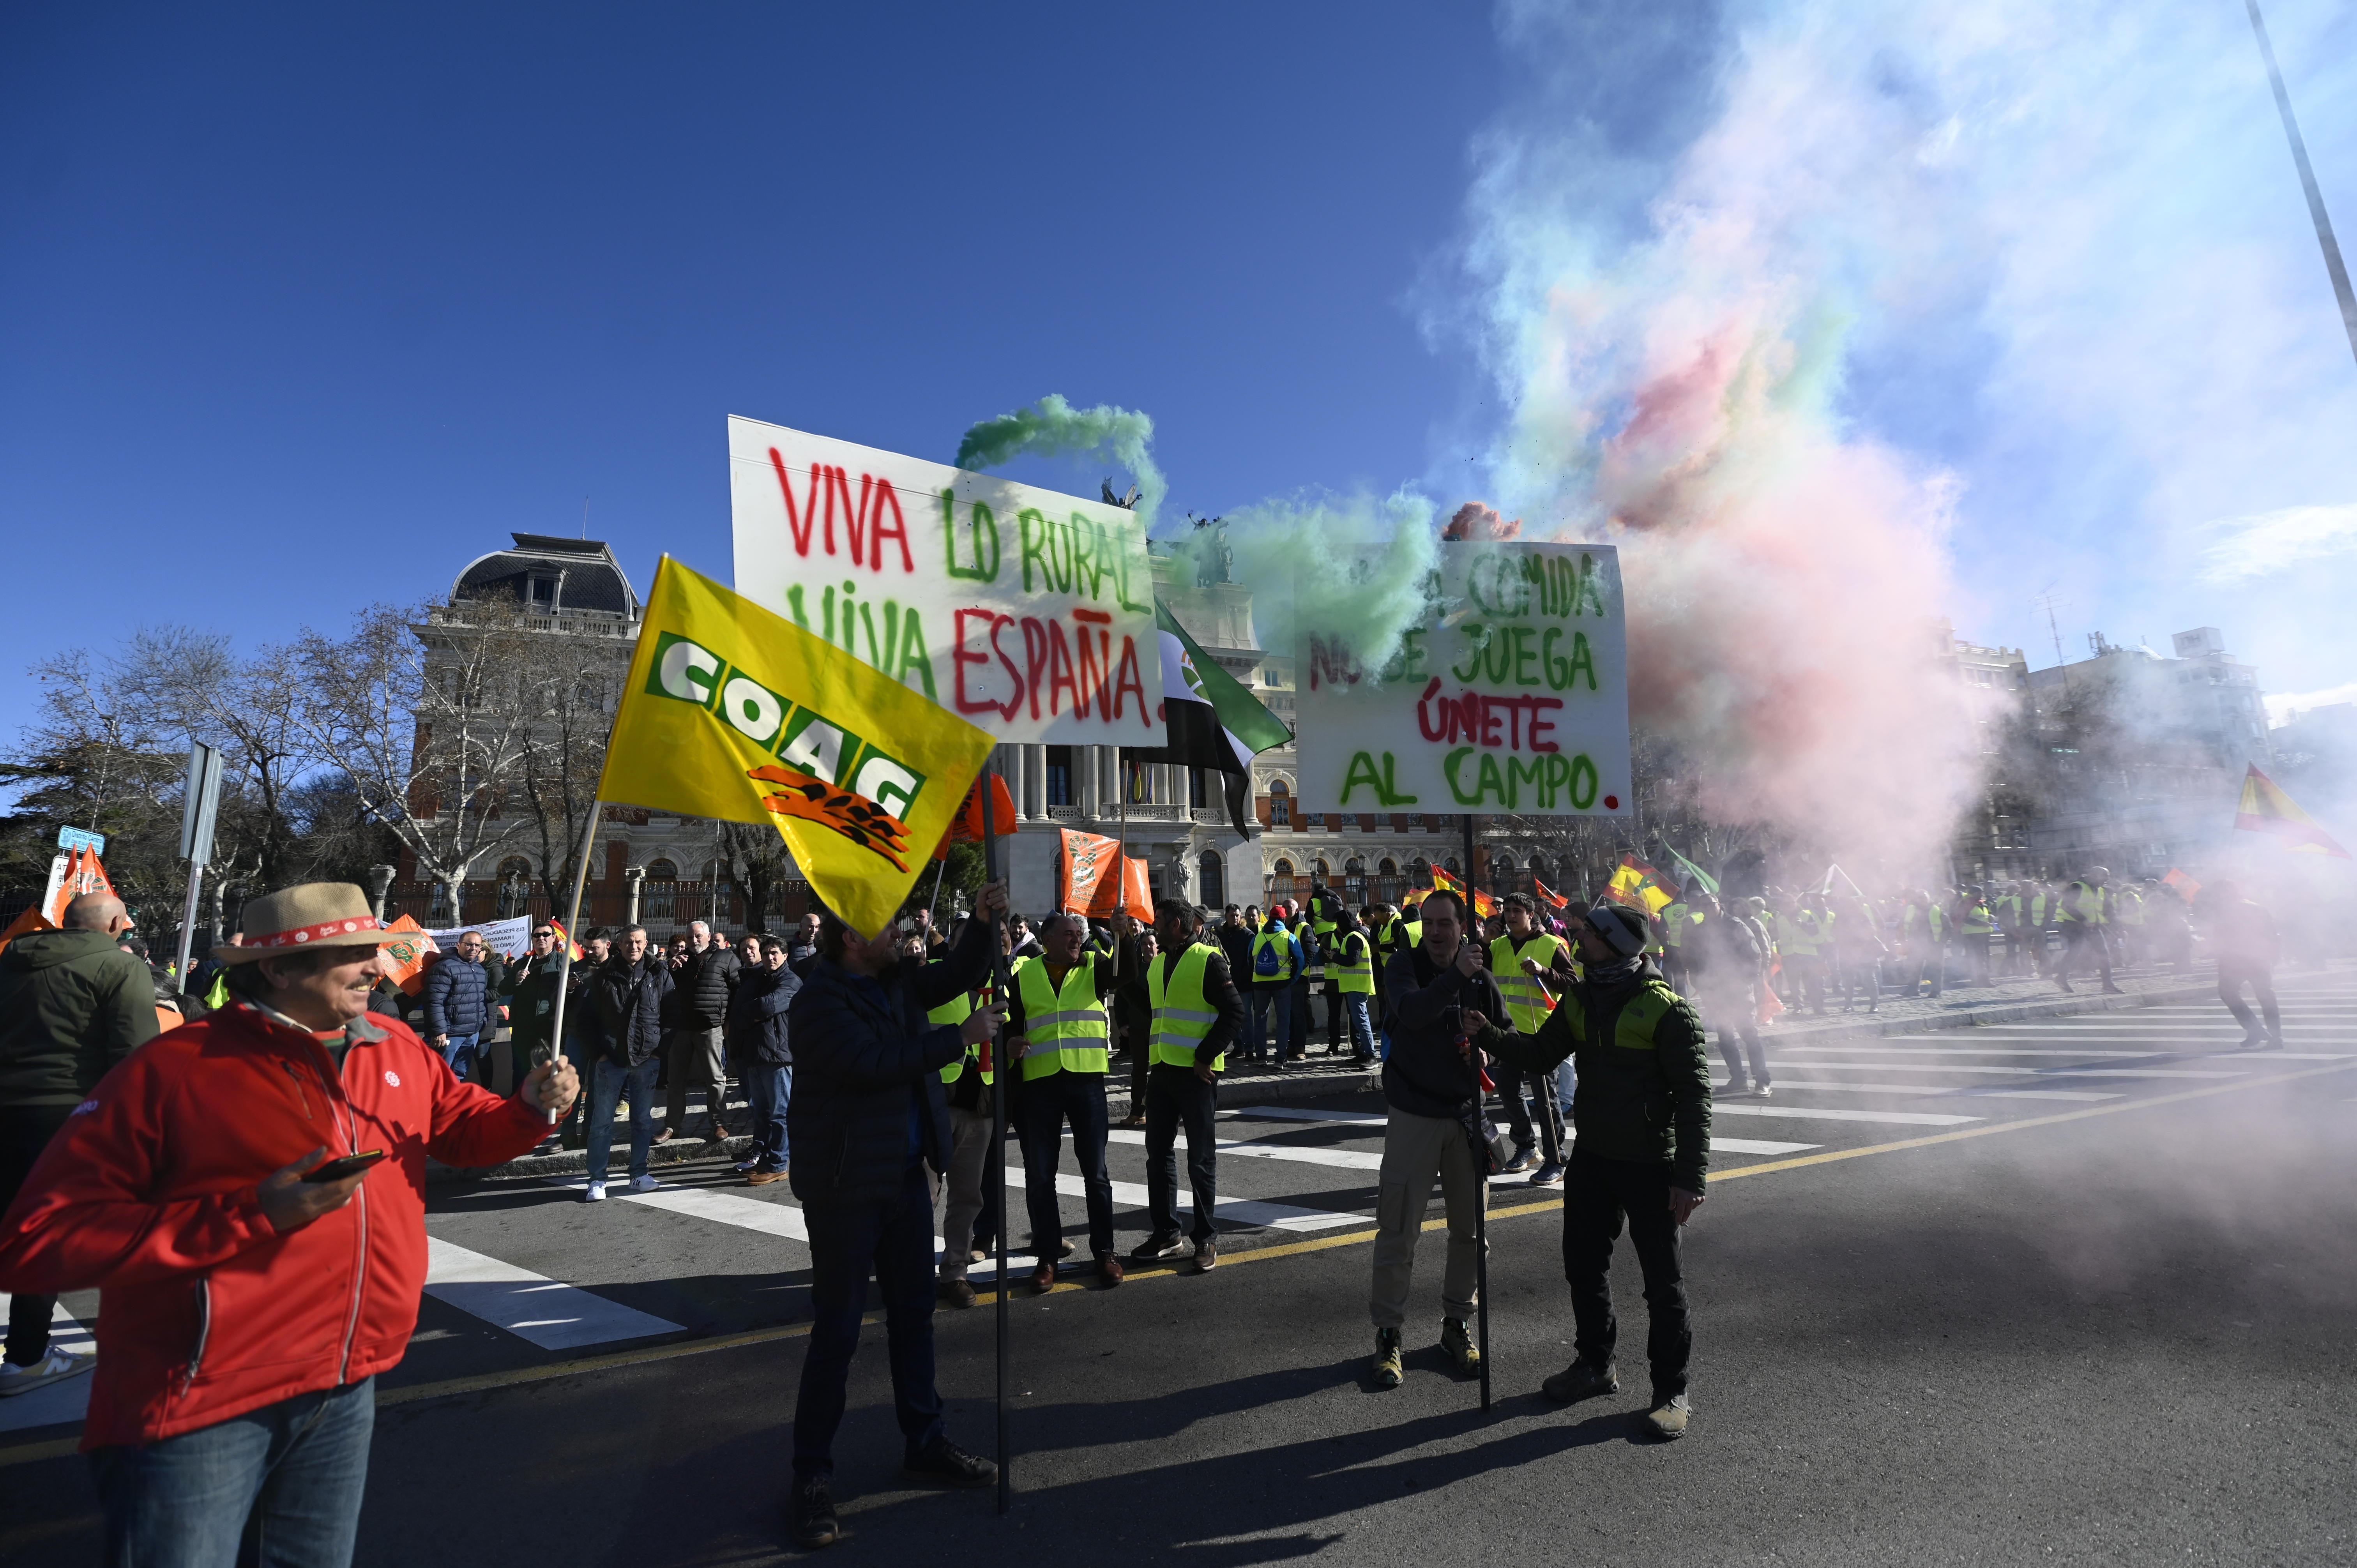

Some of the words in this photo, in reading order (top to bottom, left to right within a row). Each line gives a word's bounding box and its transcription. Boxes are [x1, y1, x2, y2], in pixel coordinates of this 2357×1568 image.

[769, 447, 914, 573] VIVA
[941, 487, 999, 583] LO
[1018, 508, 1152, 614] RURAL
[1468, 553, 1603, 618] COMIDA
[1452, 623, 1597, 691] JUEGA
[659, 641, 917, 820] COAG
[1417, 676, 1563, 752] ÚNETE
[1339, 751, 1418, 806] AL
[387, 943, 414, 964] UPA
